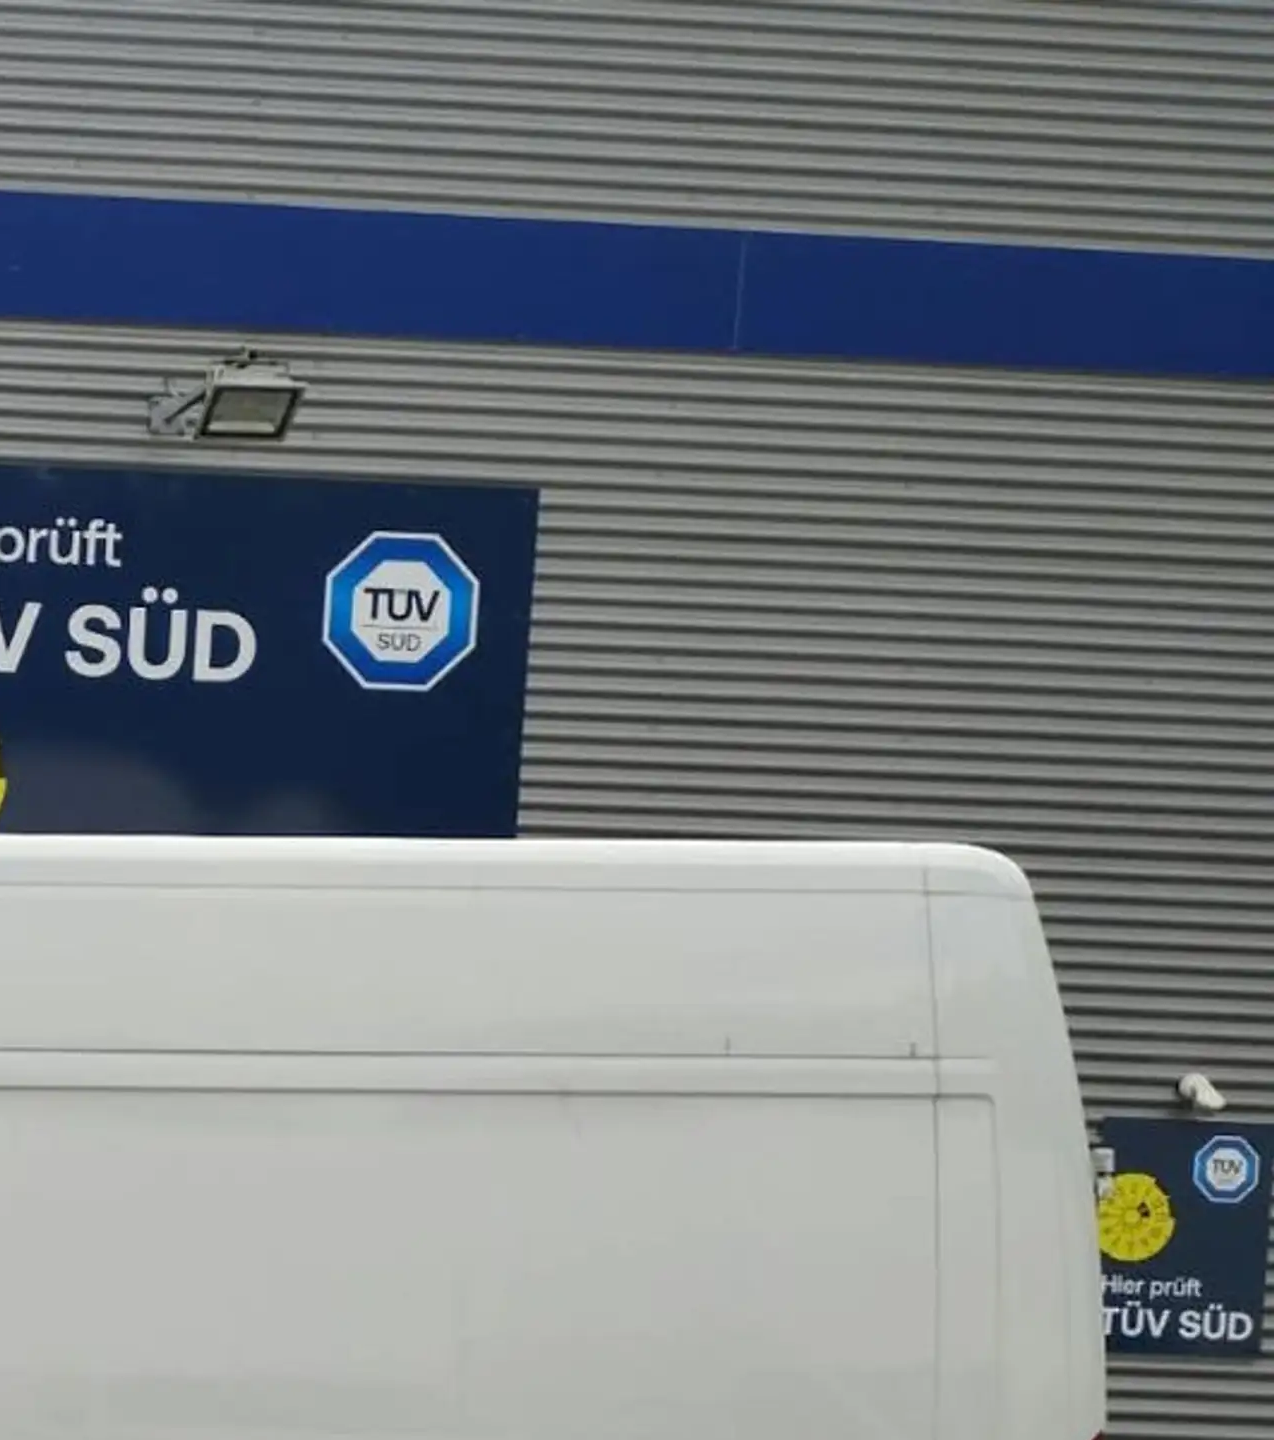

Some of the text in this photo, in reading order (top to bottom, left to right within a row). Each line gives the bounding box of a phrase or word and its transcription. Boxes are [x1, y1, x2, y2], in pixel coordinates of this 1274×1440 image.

[65, 586, 257, 684] SÜD
[1149, 1277, 1203, 1300] prüft
[1102, 1301, 1254, 1341] TÜV SÜD
